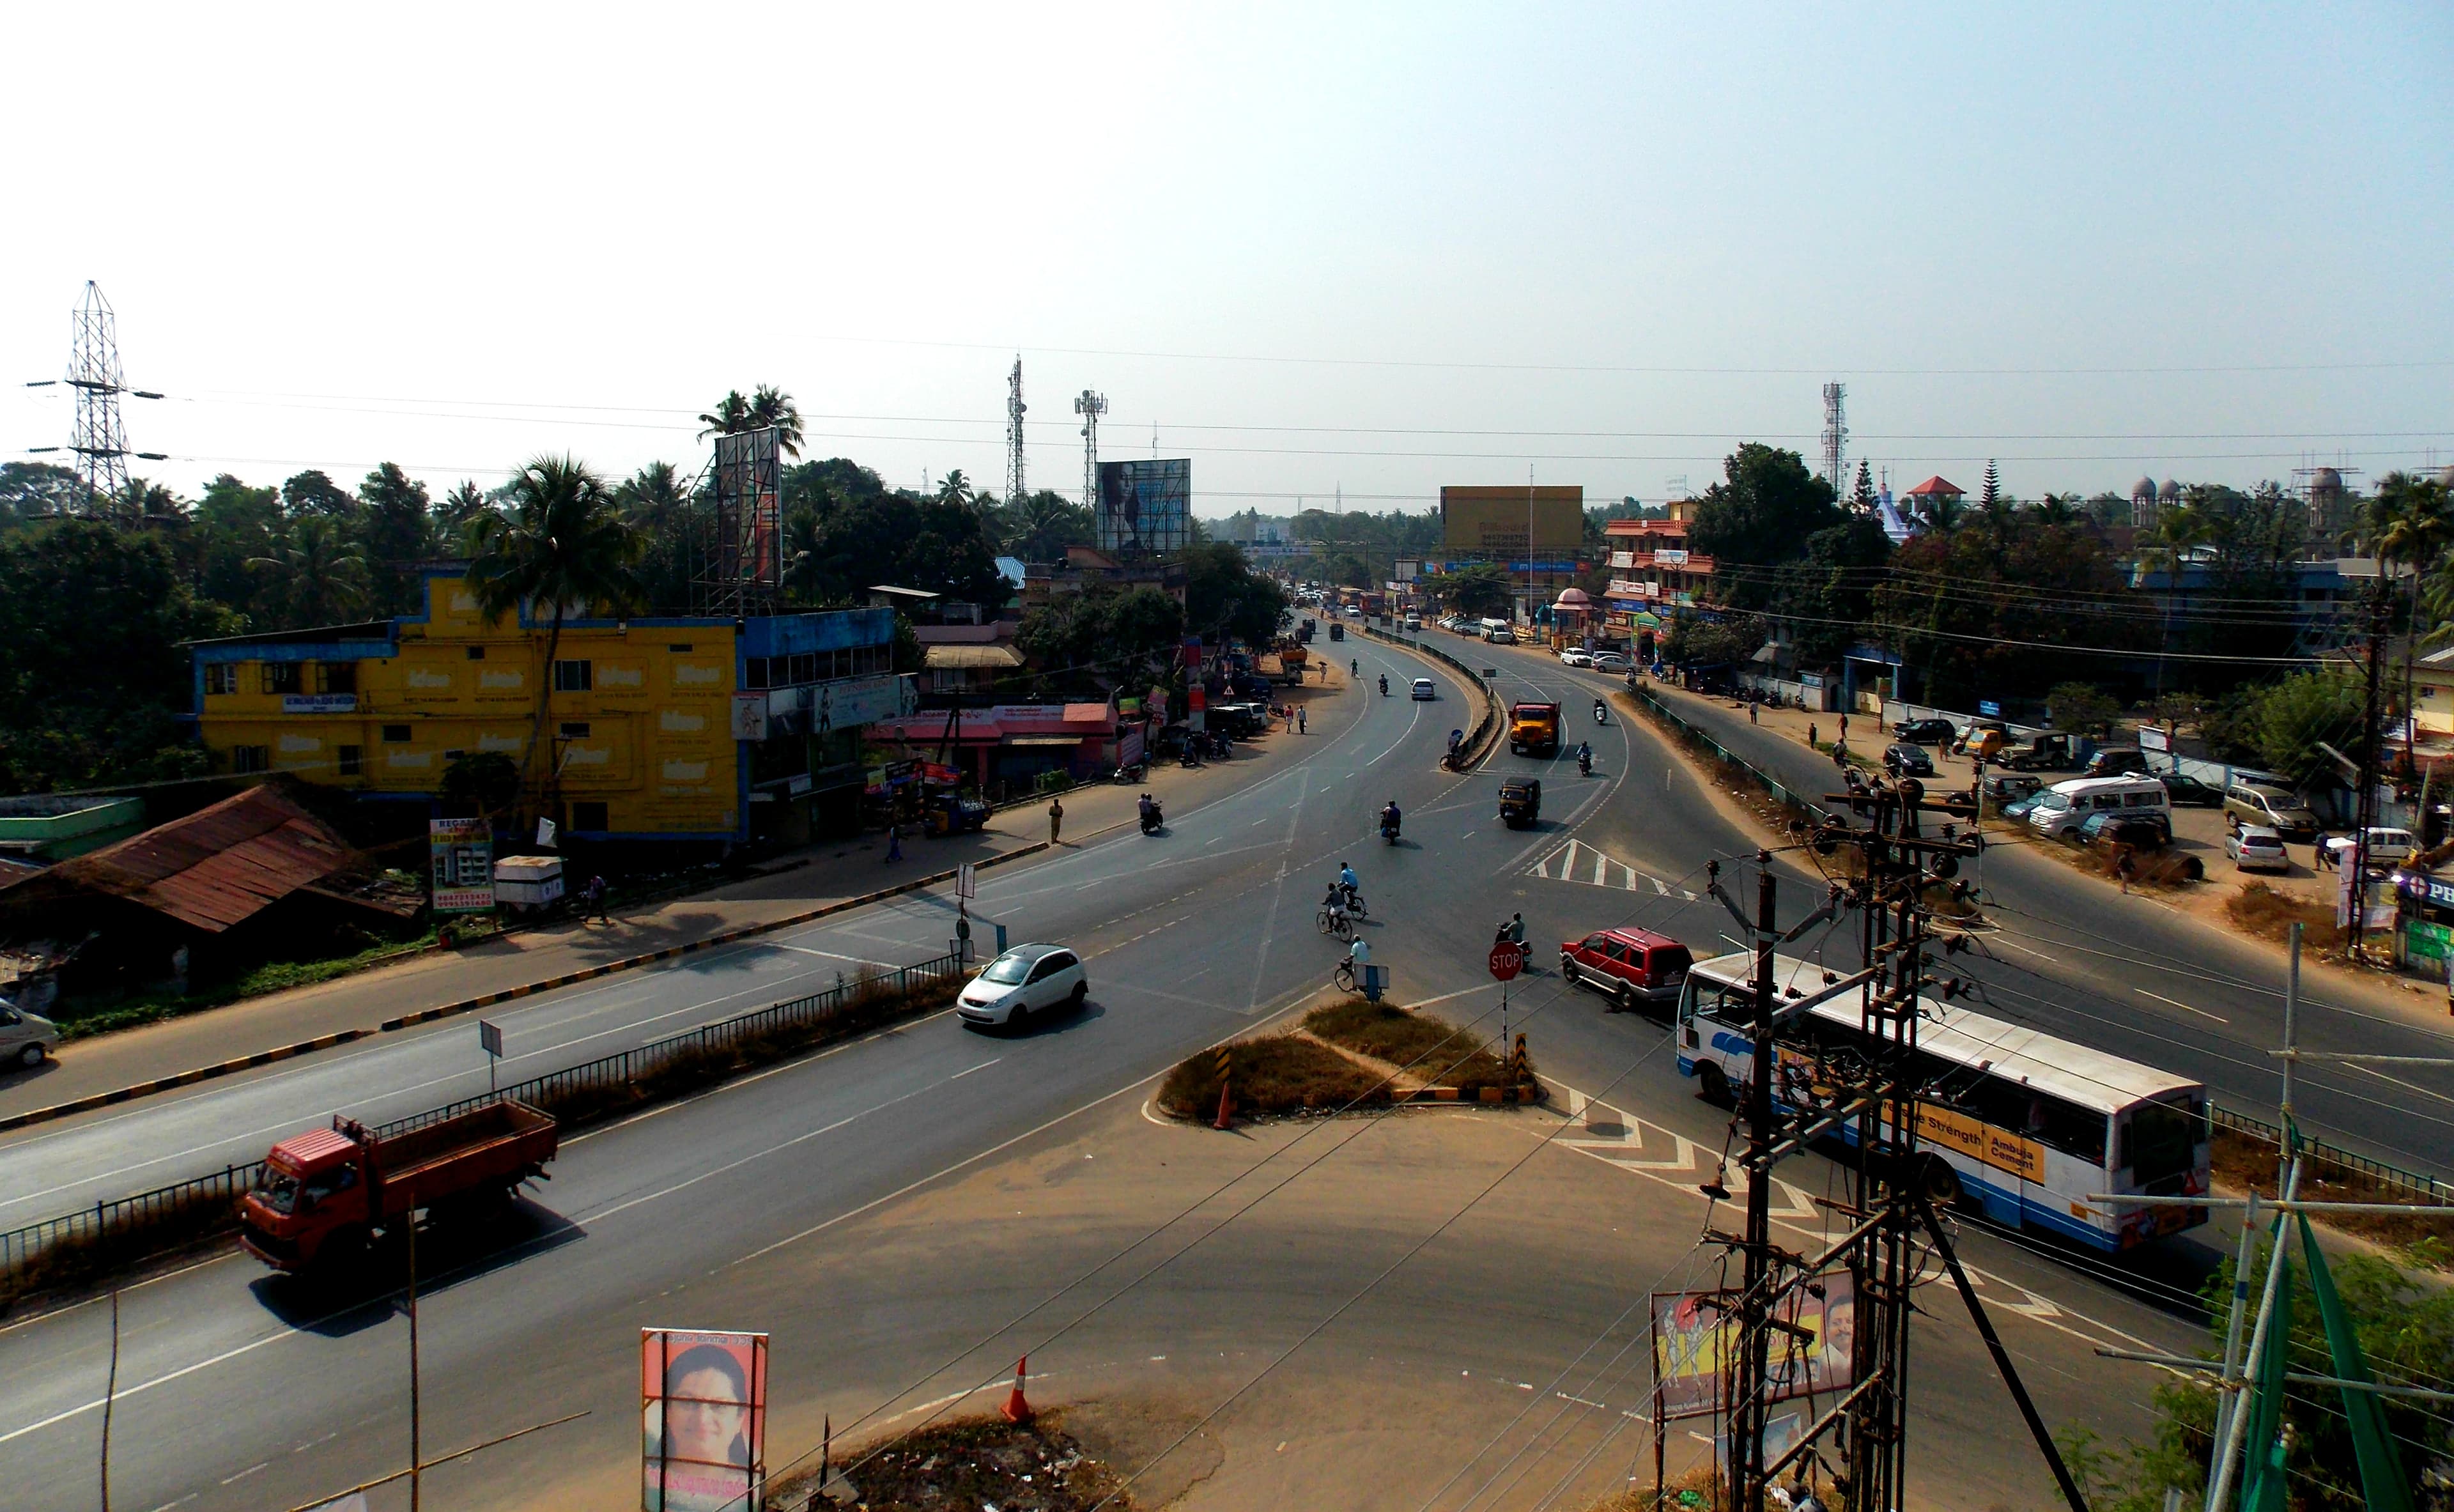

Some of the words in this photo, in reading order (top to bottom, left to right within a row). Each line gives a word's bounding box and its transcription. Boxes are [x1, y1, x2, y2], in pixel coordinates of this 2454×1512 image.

[1492, 953, 1520, 969] STOP
[1991, 1136, 2033, 1160] Ambuja
[1991, 1147, 2034, 1171] Cement
